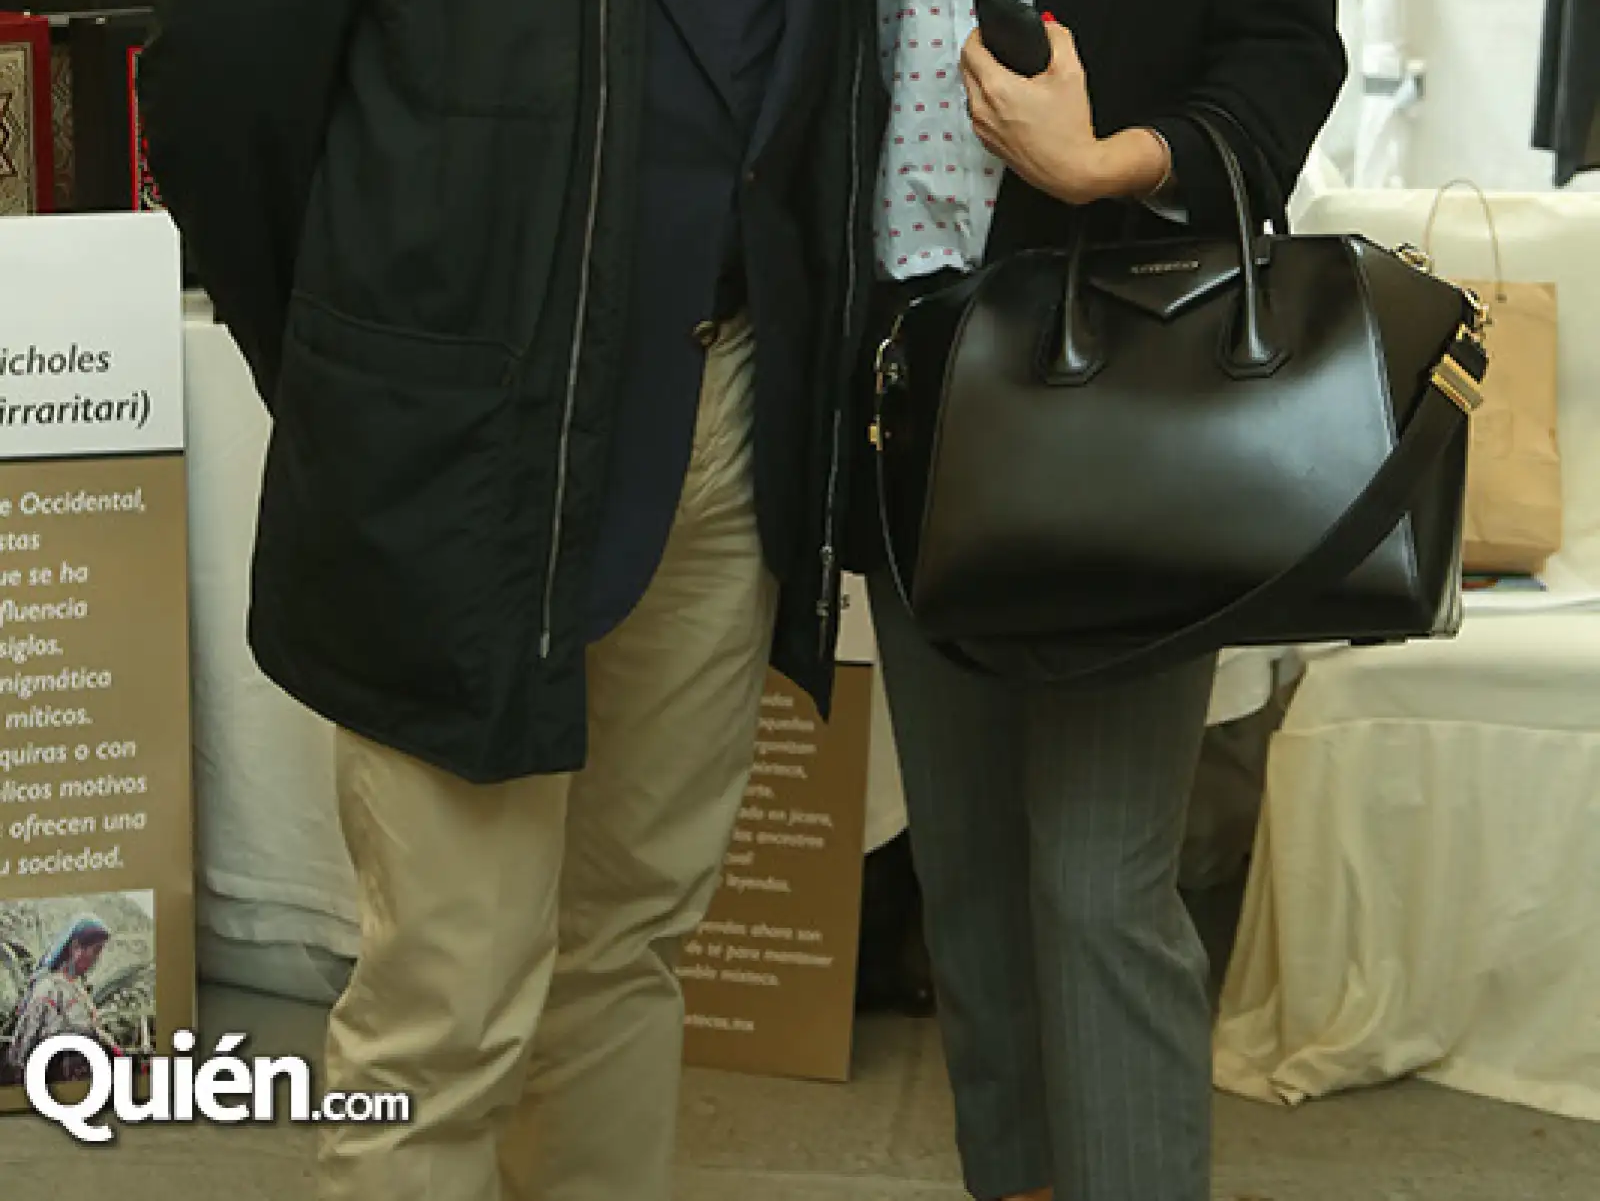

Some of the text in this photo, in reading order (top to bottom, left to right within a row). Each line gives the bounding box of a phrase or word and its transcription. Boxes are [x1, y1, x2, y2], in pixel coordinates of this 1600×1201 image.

[20, 486, 147, 515] Occidental,
[28, 567, 52, 586] se
[60, 559, 90, 584] ha
[75, 743, 90, 761] o
[96, 740, 137, 760] con
[0, 775, 148, 802] licos motivos
[9, 811, 148, 844] ofrecen una
[17, 845, 124, 875] sociedad.
